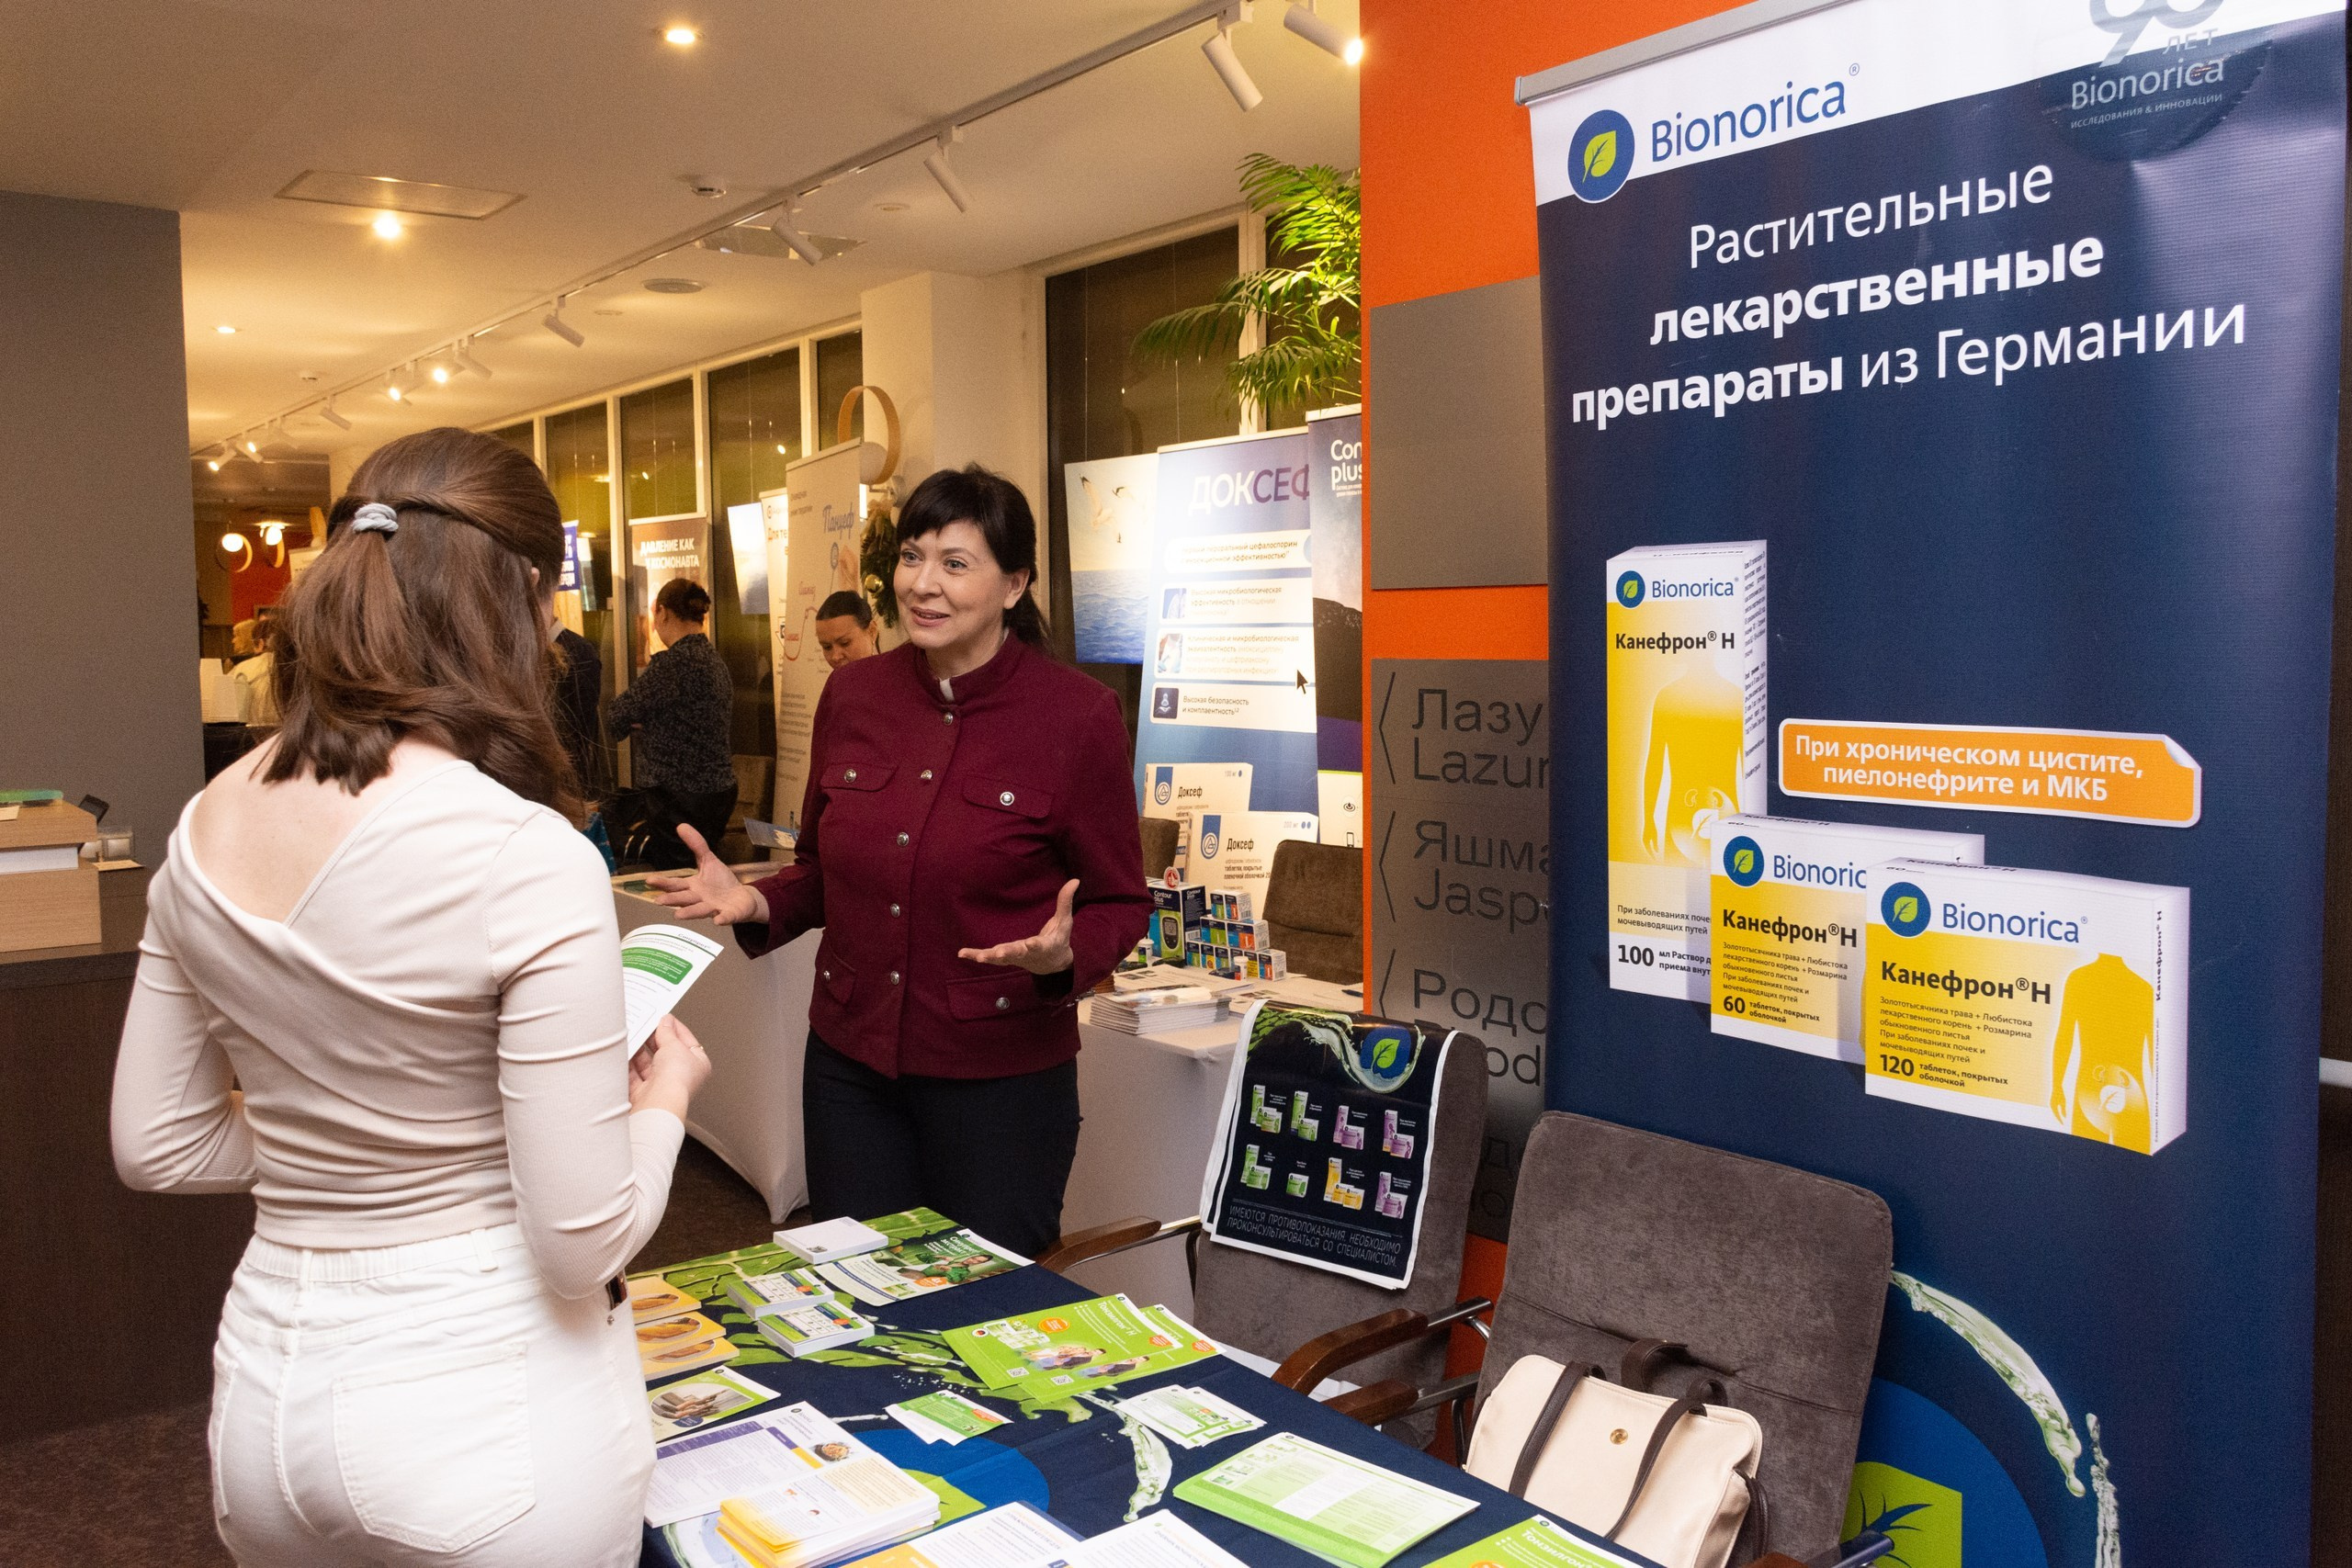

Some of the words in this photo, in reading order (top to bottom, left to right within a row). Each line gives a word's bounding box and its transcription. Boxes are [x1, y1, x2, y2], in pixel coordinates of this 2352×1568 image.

[2163, 28, 2219, 54] ЛЕТ
[2072, 59, 2224, 110] Bionorica
[2071, 107, 2143, 129] ИССЛЕДОВАНИЯ
[2145, 105, 2153, 114] &
[2154, 94, 2222, 112] ИННОВАЦИИ
[1690, 164, 2054, 270] Растительные
[1650, 236, 2105, 346] лекарственные
[1571, 350, 1844, 432] препараты
[1861, 344, 1918, 389] из
[1937, 303, 2245, 387] Германии
[640, 539, 678, 557] ДАВЛЕНИЕ
[679, 537, 695, 551] КАК
[1411, 688, 1544, 748] Лазу
[1796, 735, 1839, 761] При
[1846, 741, 2020, 766] хроническом
[2029, 750, 2143, 778] цистите,
[1178, 786, 1203, 798] Доксеф
[1824, 767, 2014, 796] пиелонефрите
[2022, 778, 2039, 795] и
[2048, 774, 2108, 801] МКБ
[1227, 838, 1254, 852] Доксеф
[1413, 868, 1547, 933] Jasp
[1617, 904, 1633, 915] При
[1634, 908, 1690, 920] заболеваниях
[1617, 918, 1683, 931] мочевыводящих
[1685, 925, 1708, 935] путей
[1618, 944, 1654, 967] 100
[1672, 951, 1704, 964] Раствор
[1659, 962, 1690, 972] приема
[1723, 942, 1781, 958] Золототысячника
[1781, 953, 1800, 962] трава
[1807, 957, 1848, 970] Любистока
[1723, 953, 1775, 967] лекарственного
[1776, 963, 1799, 973] корень
[1808, 967, 1847, 980] Розмарина
[1723, 963, 1774, 977] обыкновенного
[1776, 973, 1798, 982] листья
[1723, 972, 1736, 981] При
[1737, 975, 1782, 989] заболеваниях
[1784, 985, 1804, 994] почек
[1414, 968, 1547, 1036] Родо
[1723, 983, 1778, 999] мочевыводящих
[1779, 994, 1798, 1003] путей
[1724, 996, 1746, 1014] 60
[1749, 1001, 1782, 1014] таблеток,
[1784, 1009, 1820, 1021] покрытых
[1749, 1010, 1787, 1023] оболочкой
[1880, 997, 1949, 1015] Золототысячника
[1950, 1010, 1973, 1019] трава
[1983, 1013, 2032, 1027] Любистока
[1880, 1009, 1940, 1025] лекарственного
[1942, 1020, 1973, 1031] корень
[1983, 1025, 2031, 1039] Розмарина
[1880, 1020, 1940, 1036] обыкновенного
[1942, 1031, 1970, 1040] листья
[1880, 1030, 1895, 1040] При
[1897, 1032, 1951, 1049] заболеваниях
[1953, 1043, 1978, 1054] почек
[1880, 1041, 1945, 1059] мочевыводящих
[1946, 1052, 1970, 1063] путей
[1880, 1054, 1915, 1077] 120
[1919, 1063, 1960, 1077] таблеток,
[1962, 1071, 2008, 1085] покрытых
[1919, 1073, 1965, 1088] оболочкой
[1227, 1217, 1319, 1248] ПРОКОНСУЛЬТИРОВАТЬСЯ
[1323, 1239, 1333, 1252] СО
[1337, 1243, 1396, 1268] СПЕЦИАЛИСТОМ.
[1229, 1205, 1265, 1222] ИМЕЮТСЯ
[1350, 1233, 1401, 1254] НЕОБХОДИМО
